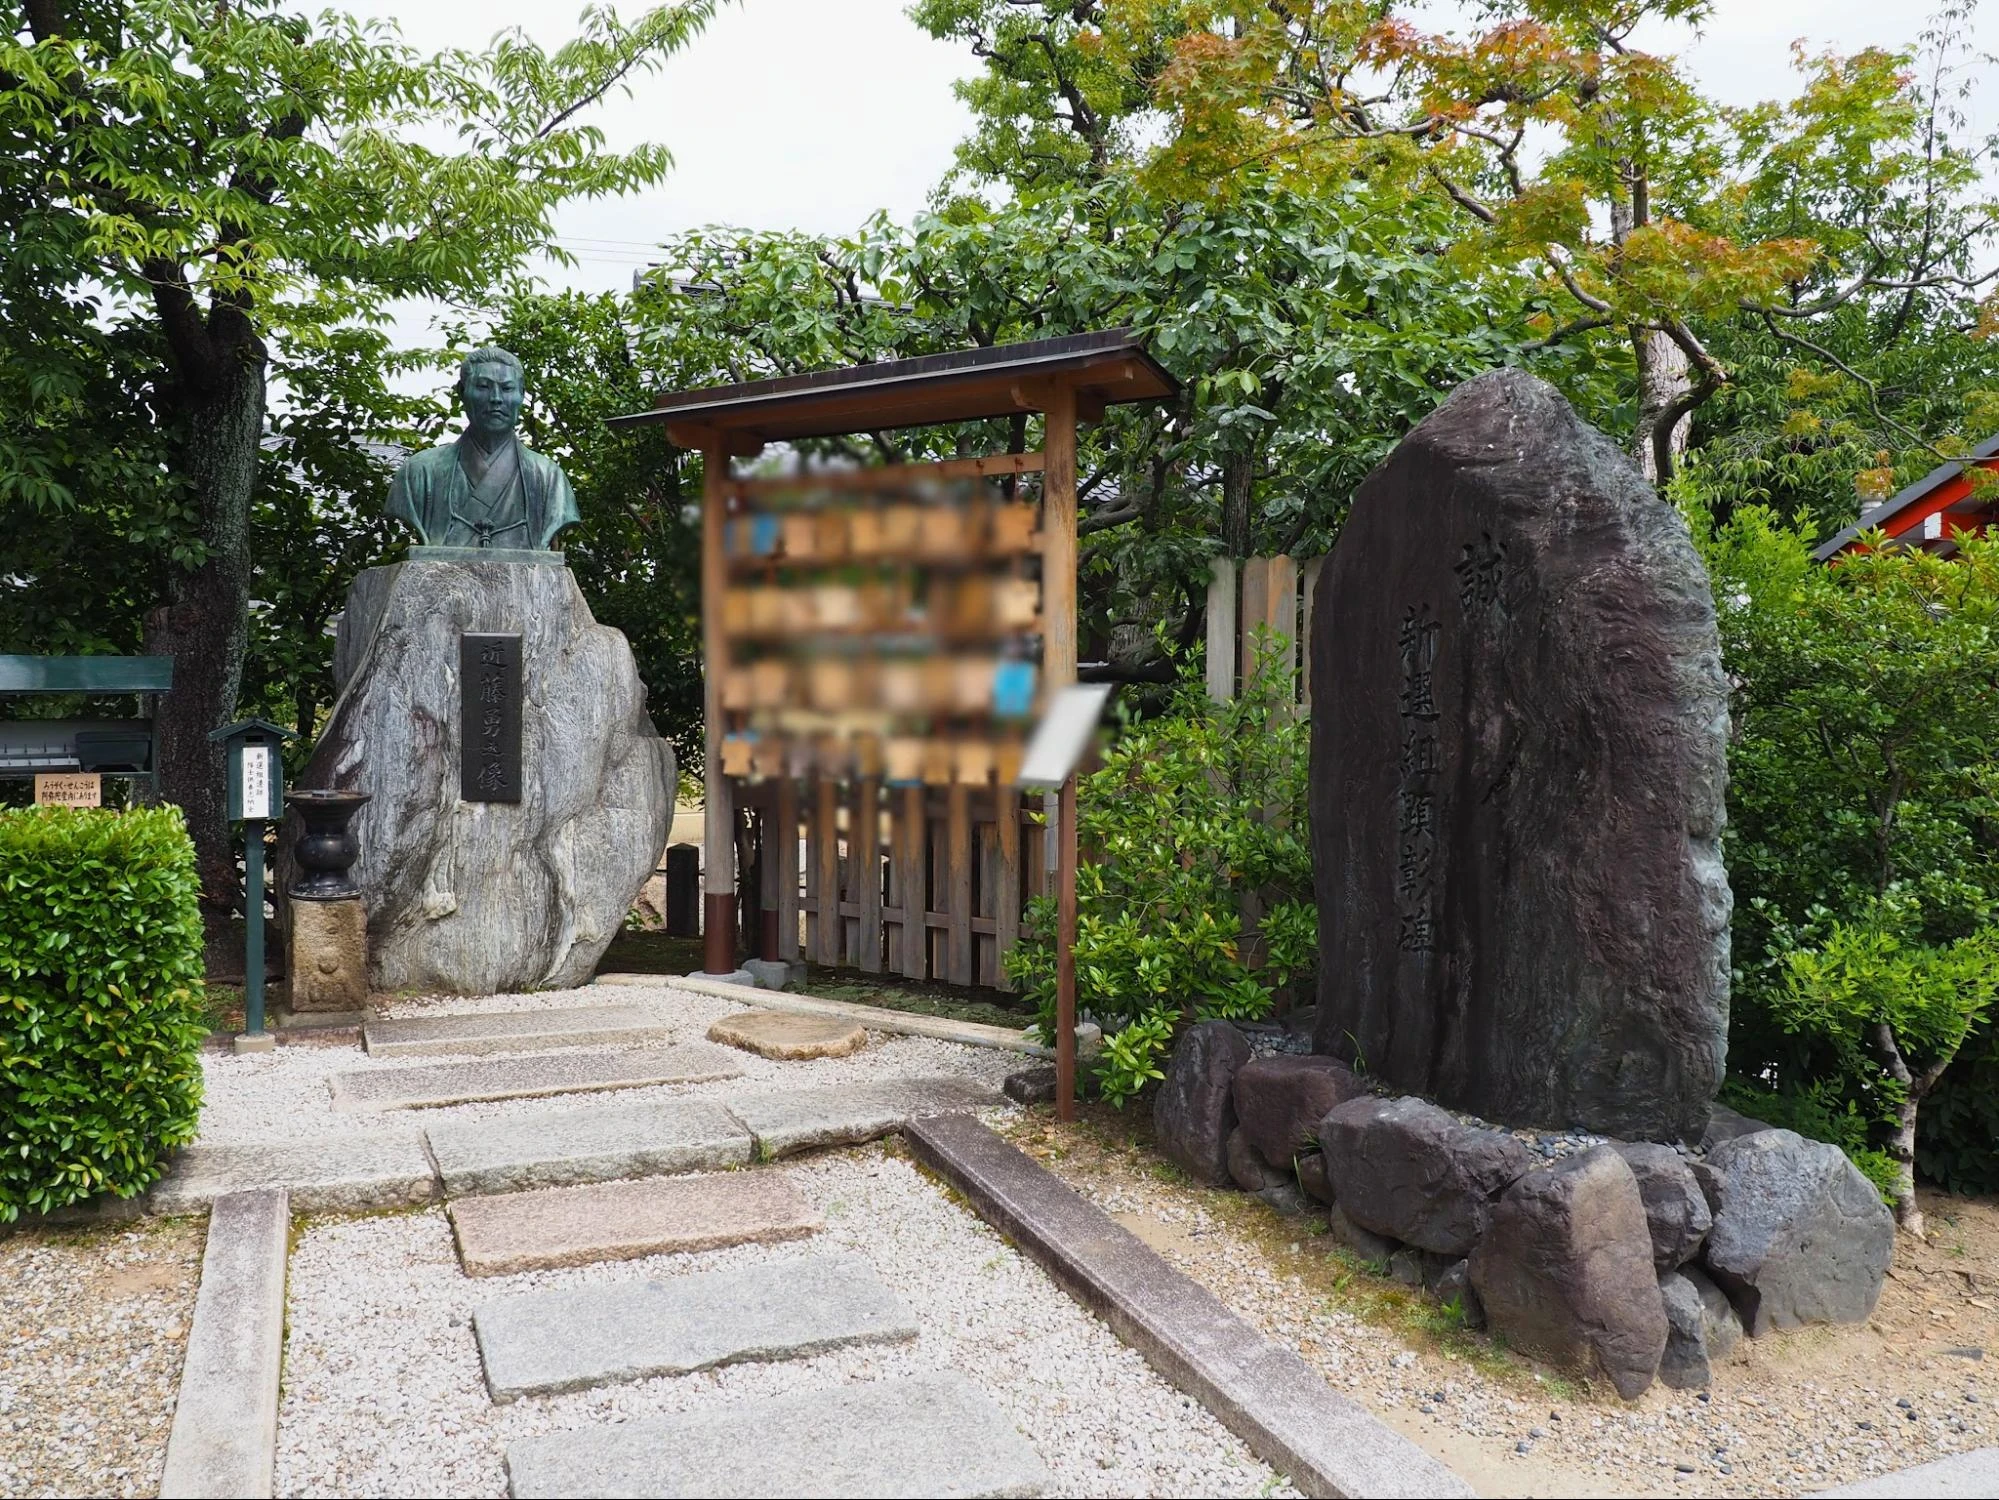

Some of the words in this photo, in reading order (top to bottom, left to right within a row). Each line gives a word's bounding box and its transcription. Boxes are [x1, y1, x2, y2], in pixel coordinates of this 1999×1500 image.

[1453, 531, 1511, 617] 誠
[477, 640, 508, 796] 近藤勇之像
